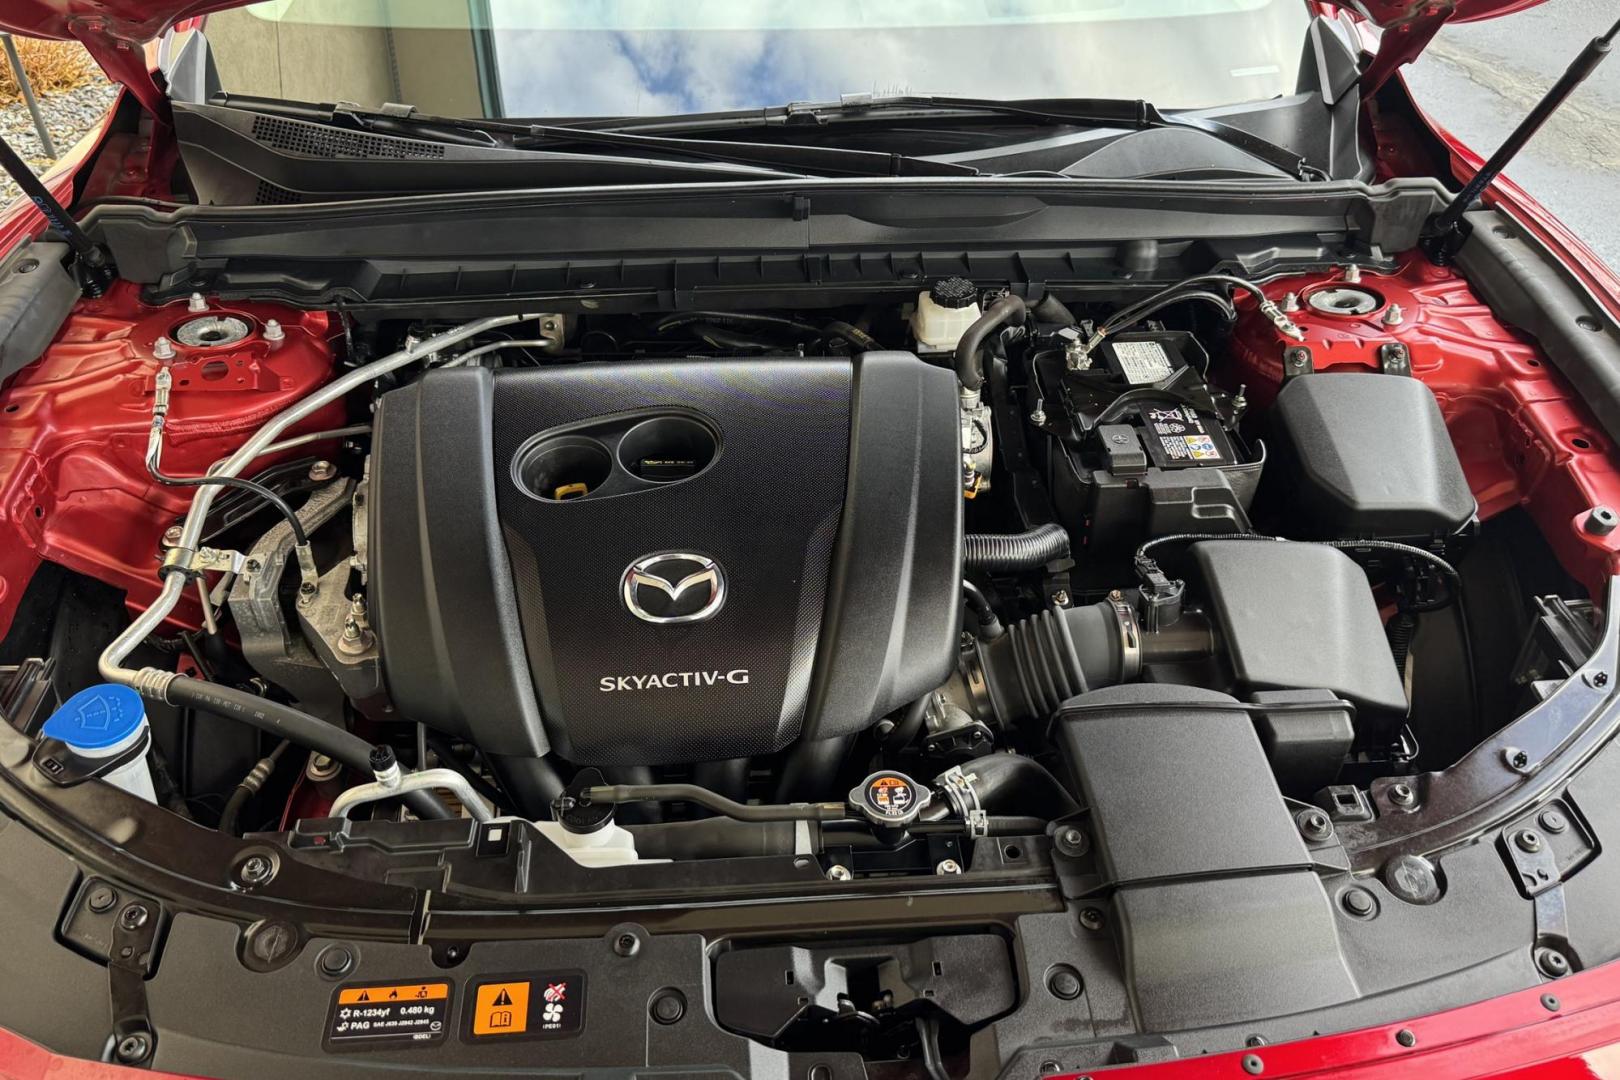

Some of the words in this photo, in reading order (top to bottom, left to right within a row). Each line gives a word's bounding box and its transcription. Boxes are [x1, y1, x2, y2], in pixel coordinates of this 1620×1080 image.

[599, 669, 749, 692] SKYACTIV-G
[353, 1008, 390, 1018] R-1234yf
[400, 1006, 422, 1015] 0.480
[423, 1005, 435, 1015] kg
[350, 1021, 370, 1030] PAG
